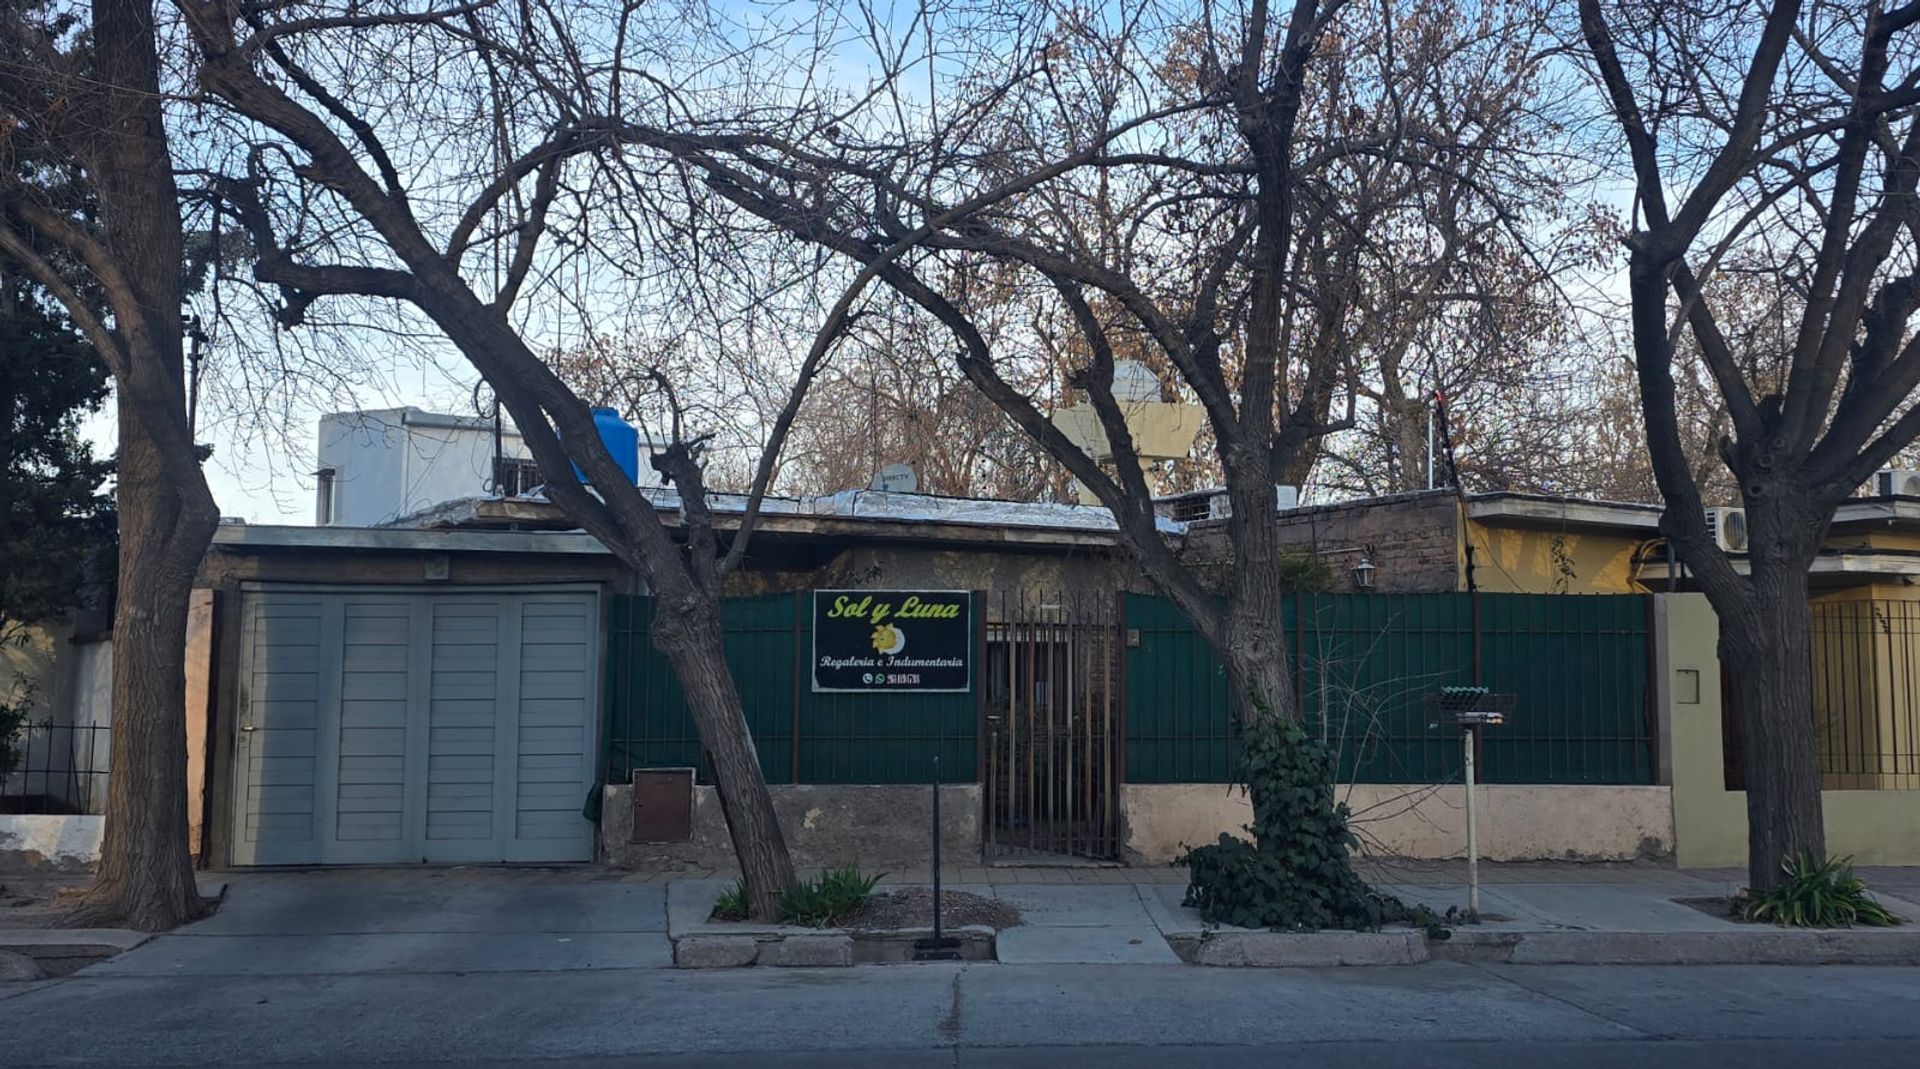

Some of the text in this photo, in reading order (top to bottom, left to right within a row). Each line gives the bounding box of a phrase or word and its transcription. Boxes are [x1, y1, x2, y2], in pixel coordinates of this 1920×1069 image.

[827, 596, 960, 624] Sol y Luna
[877, 658, 884, 667] e
[886, 655, 964, 667] Indumentaria
